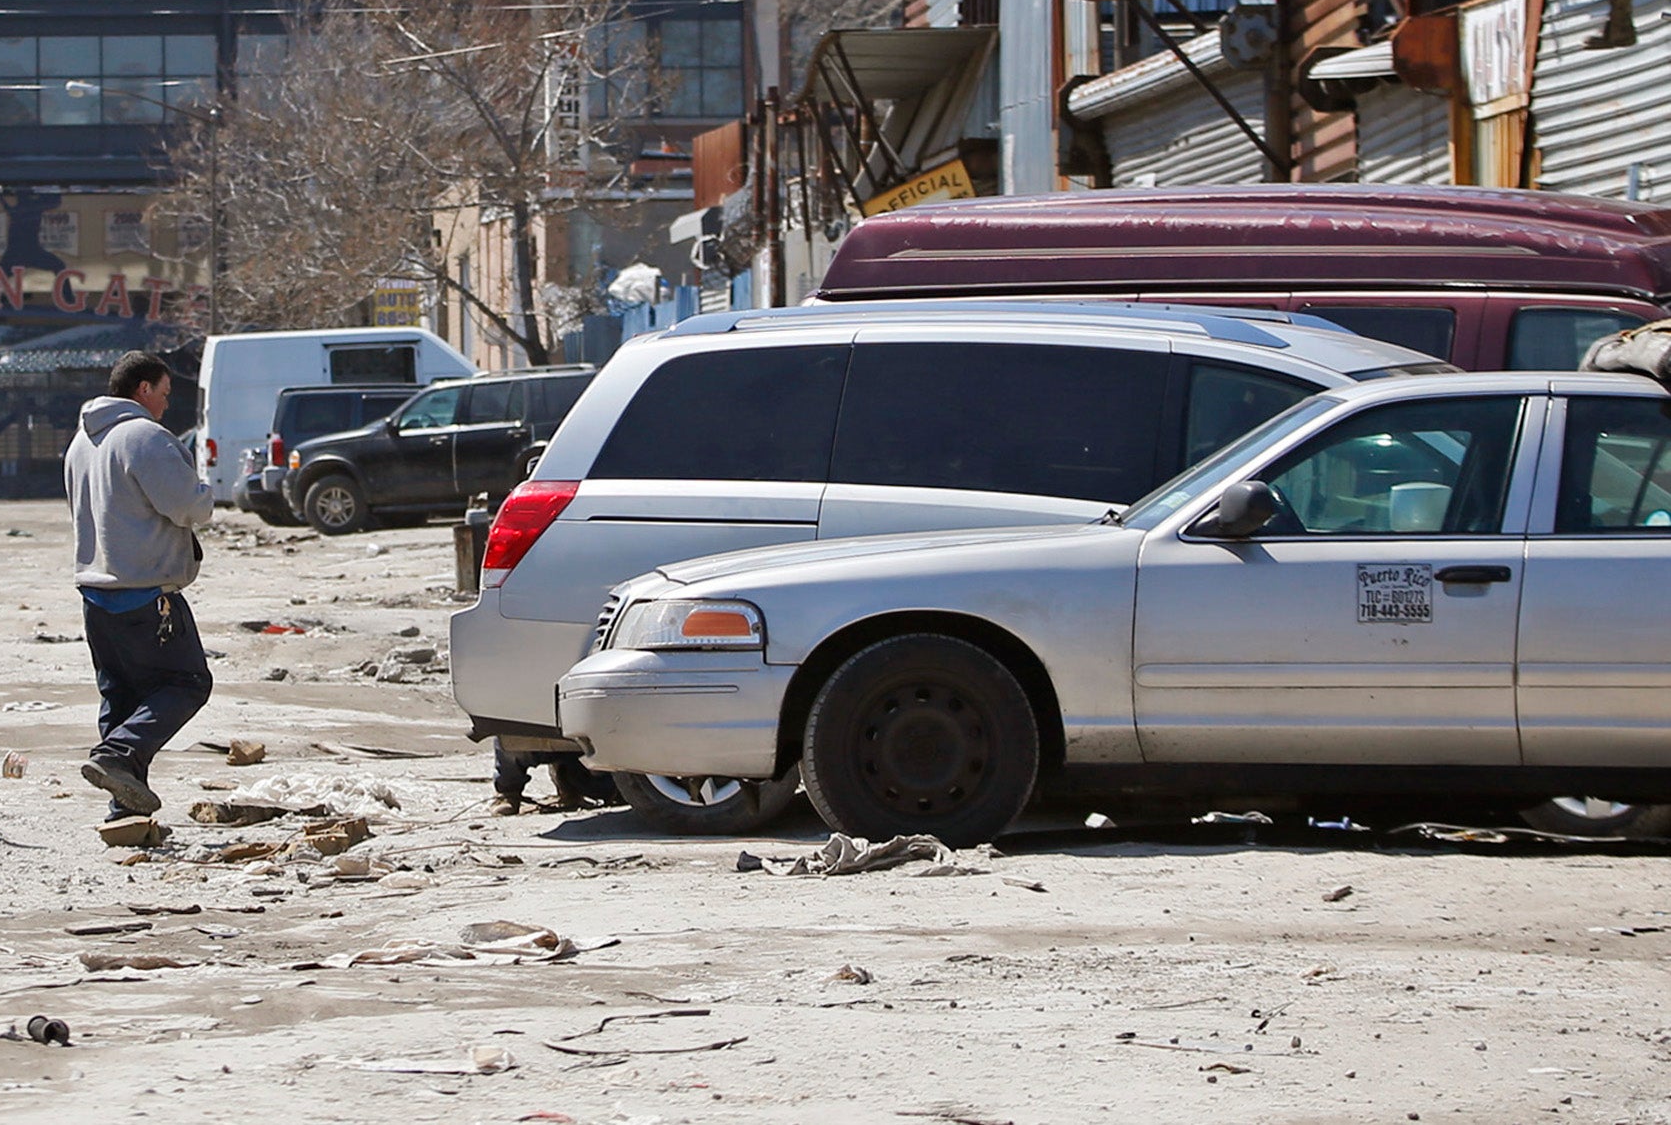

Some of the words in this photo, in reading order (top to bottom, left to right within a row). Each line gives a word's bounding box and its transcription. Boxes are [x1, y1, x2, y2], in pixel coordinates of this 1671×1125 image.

[878, 172, 963, 215] FFICIAL
[52, 268, 213, 328] GATE
[1359, 568, 1400, 588] Puerto
[1402, 567, 1431, 588] Rico
[1365, 590, 1382, 604] TLC
[1360, 604, 1430, 618] 718-443-5555
